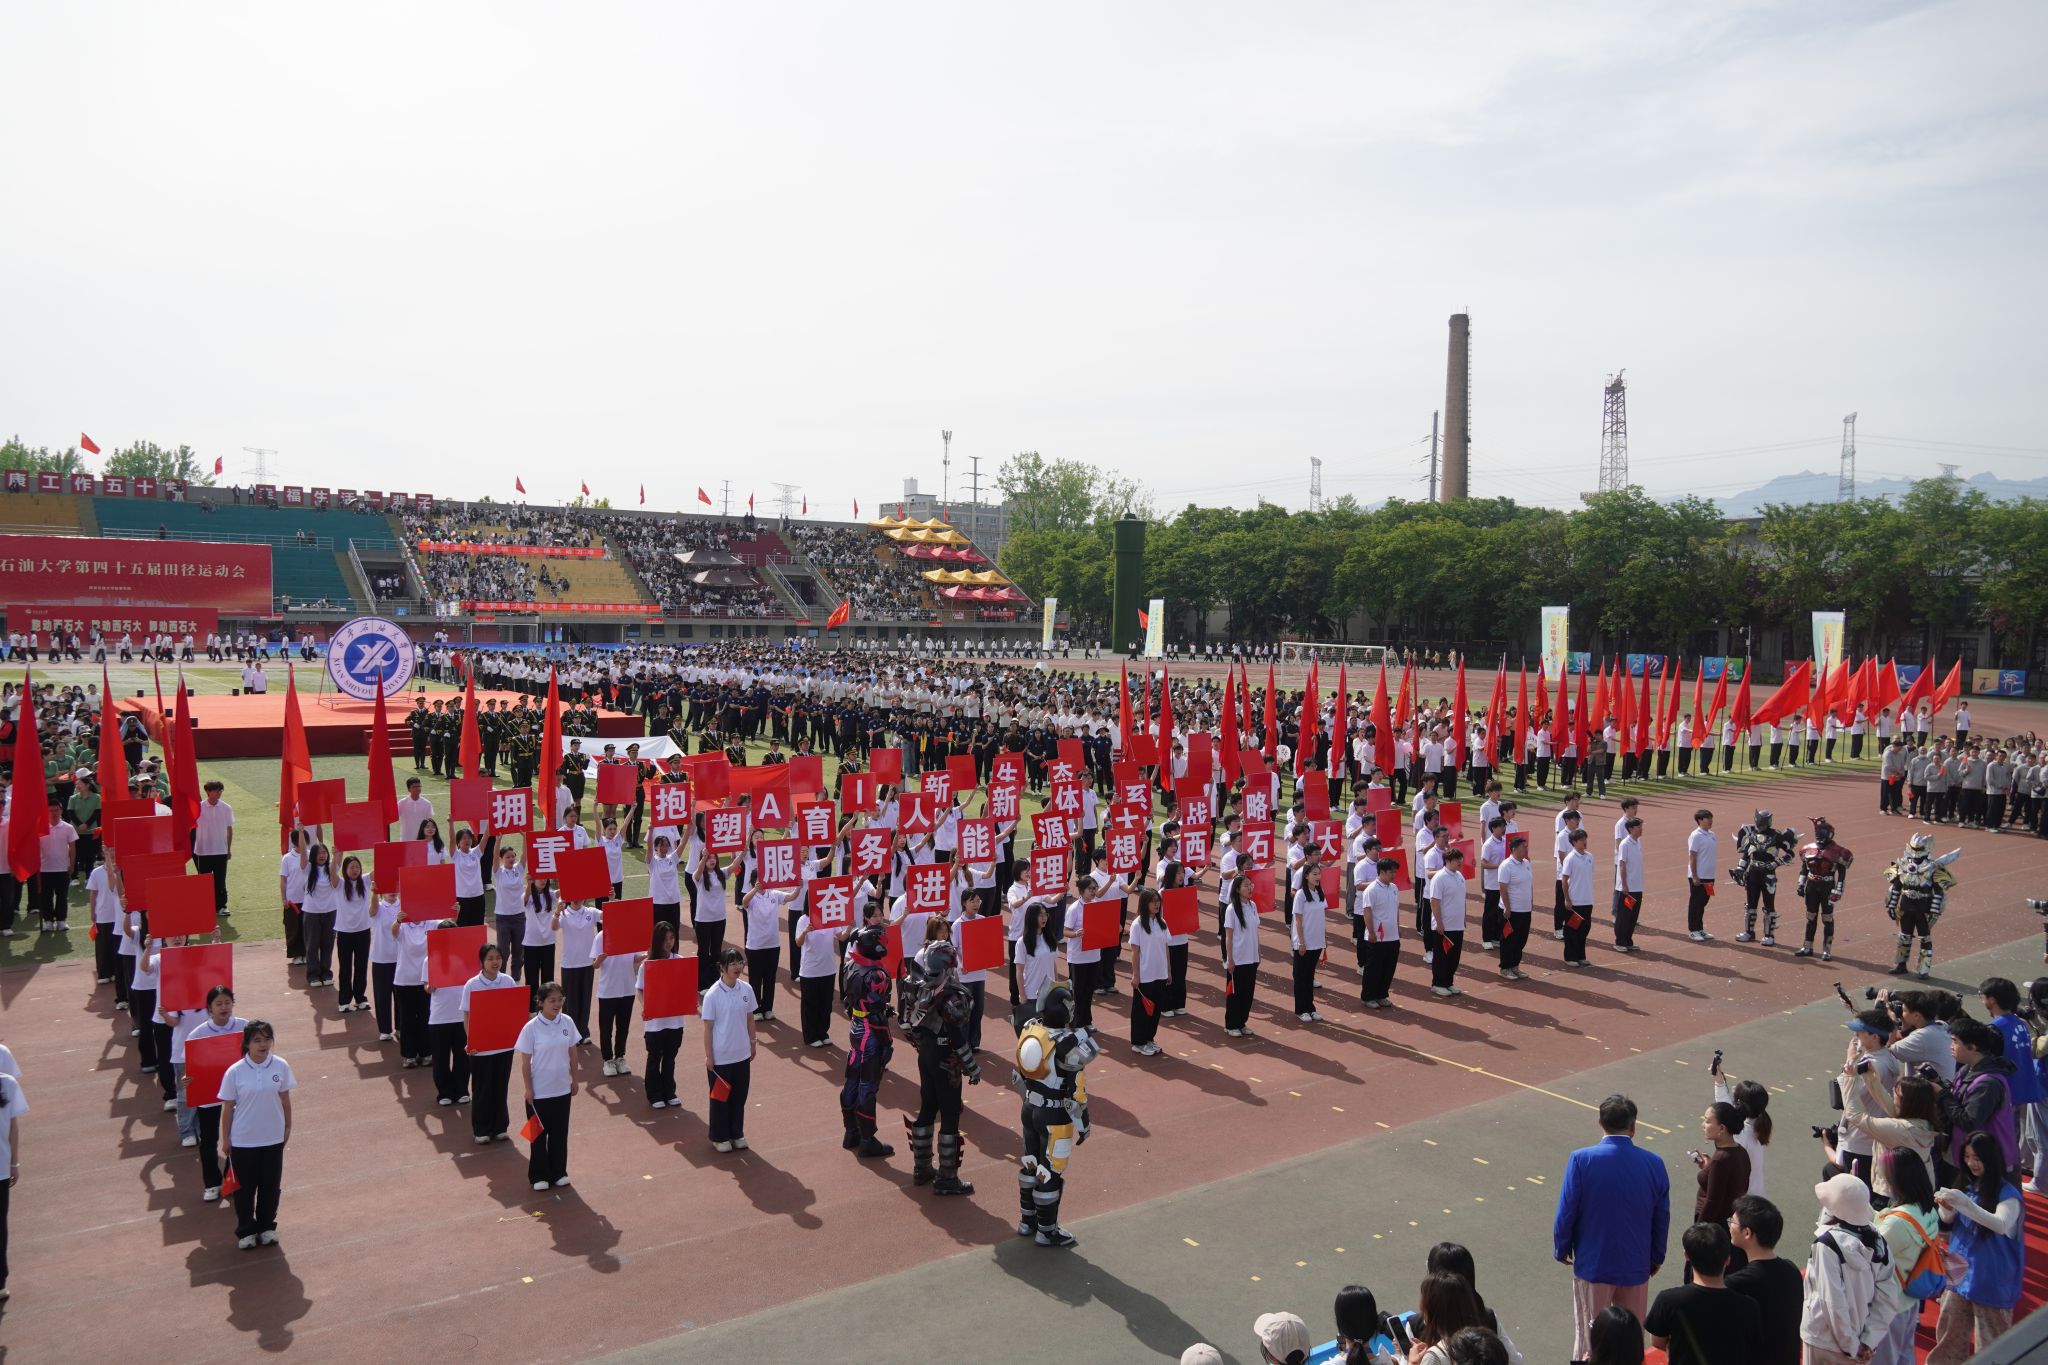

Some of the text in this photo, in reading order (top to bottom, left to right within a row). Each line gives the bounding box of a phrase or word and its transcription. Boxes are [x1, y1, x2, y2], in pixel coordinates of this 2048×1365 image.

[0, 558, 246, 578] 石油大学第四十五届田径运动会
[382, 657, 409, 691] NIVERSITY
[493, 794, 526, 828] 拥
[656, 787, 687, 820] 抱
[759, 794, 781, 819] A
[925, 774, 949, 802] 新
[997, 763, 1017, 781] 生
[1053, 762, 1073, 781] 态
[533, 784, 1147, 872] 重 塑 育 人 新 体 系
[764, 846, 796, 882] 服
[857, 834, 887, 870] 务
[962, 824, 990, 858] 能
[1037, 817, 1068, 848] 源
[1187, 802, 1207, 824] 战
[1247, 792, 1268, 821] 略
[816, 827, 1338, 923] 奋 进 理 想 西 石 大
